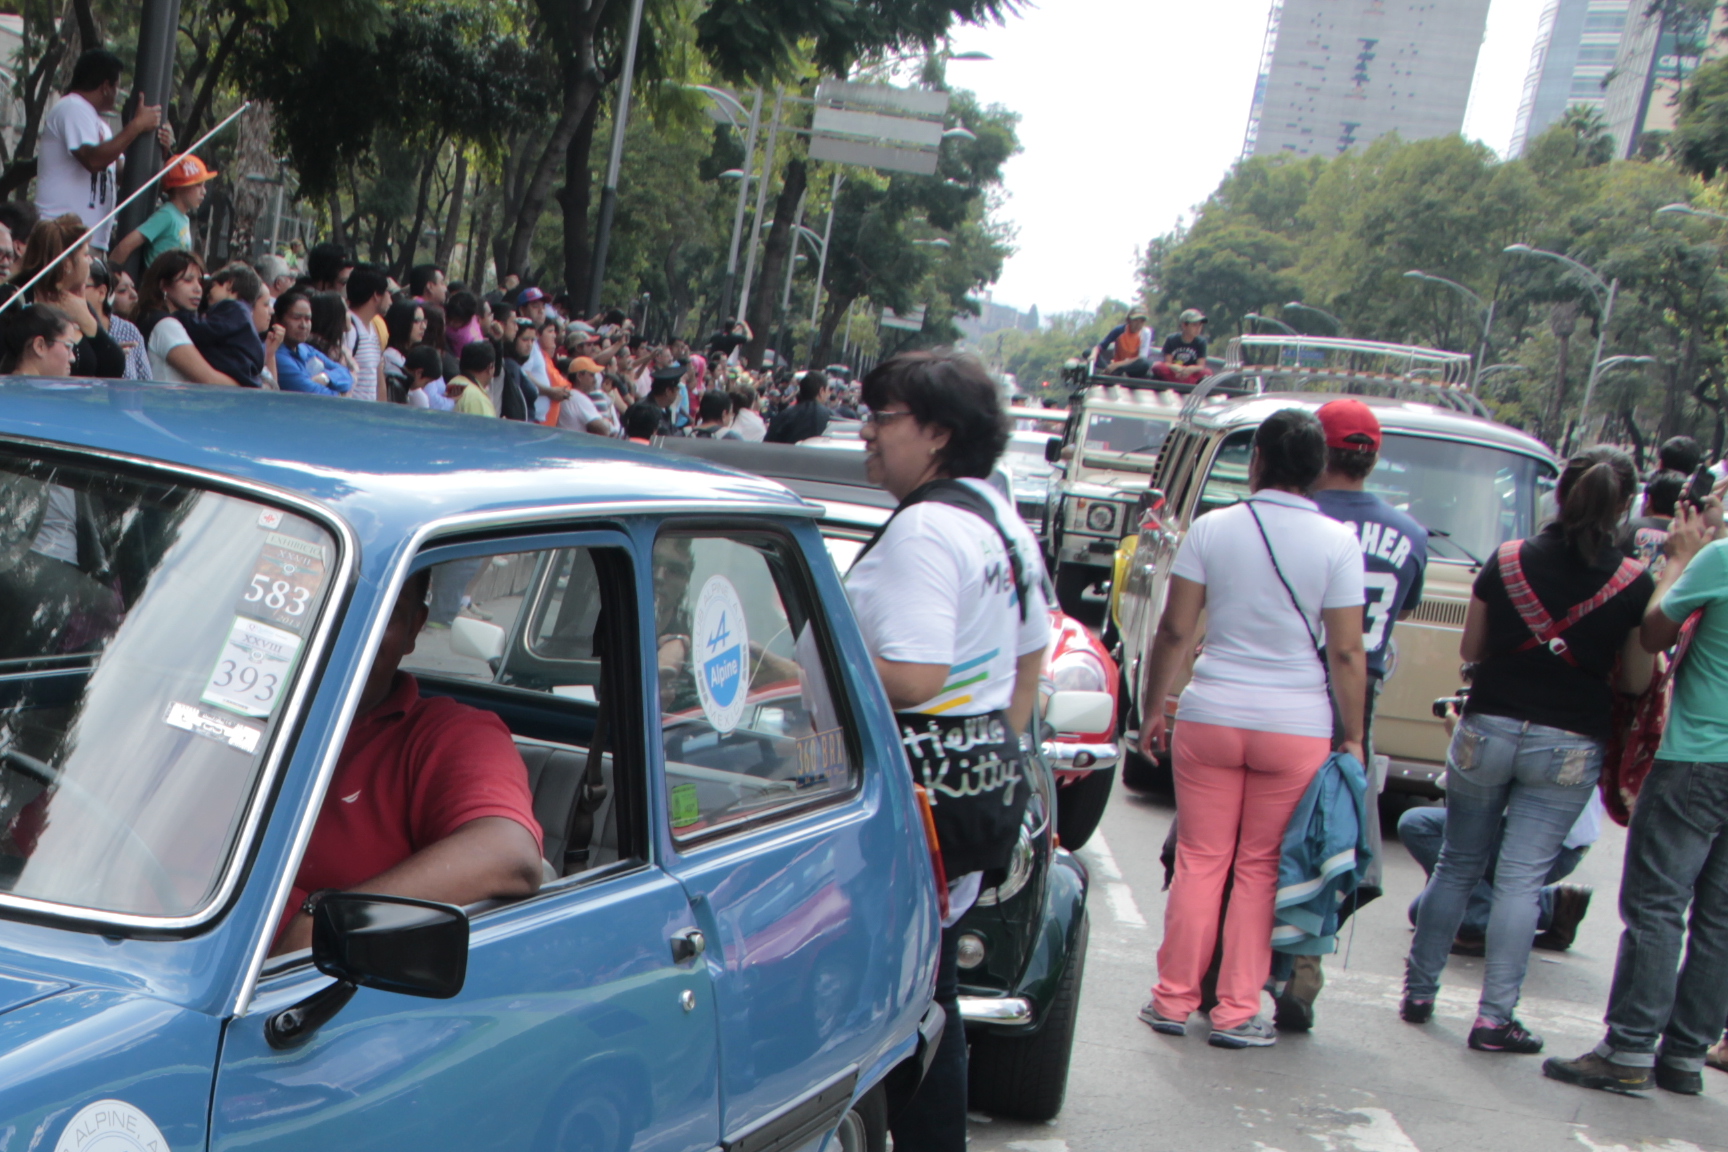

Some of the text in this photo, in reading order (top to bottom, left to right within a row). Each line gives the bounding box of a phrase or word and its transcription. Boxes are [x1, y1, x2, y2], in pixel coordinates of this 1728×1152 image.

[244, 573, 310, 616] 583
[243, 634, 283, 653] XXVIII
[213, 660, 278, 701] 393
[711, 659, 738, 688] Alpine
[903, 715, 1005, 758] Hello
[923, 752, 1022, 806] Kitty
